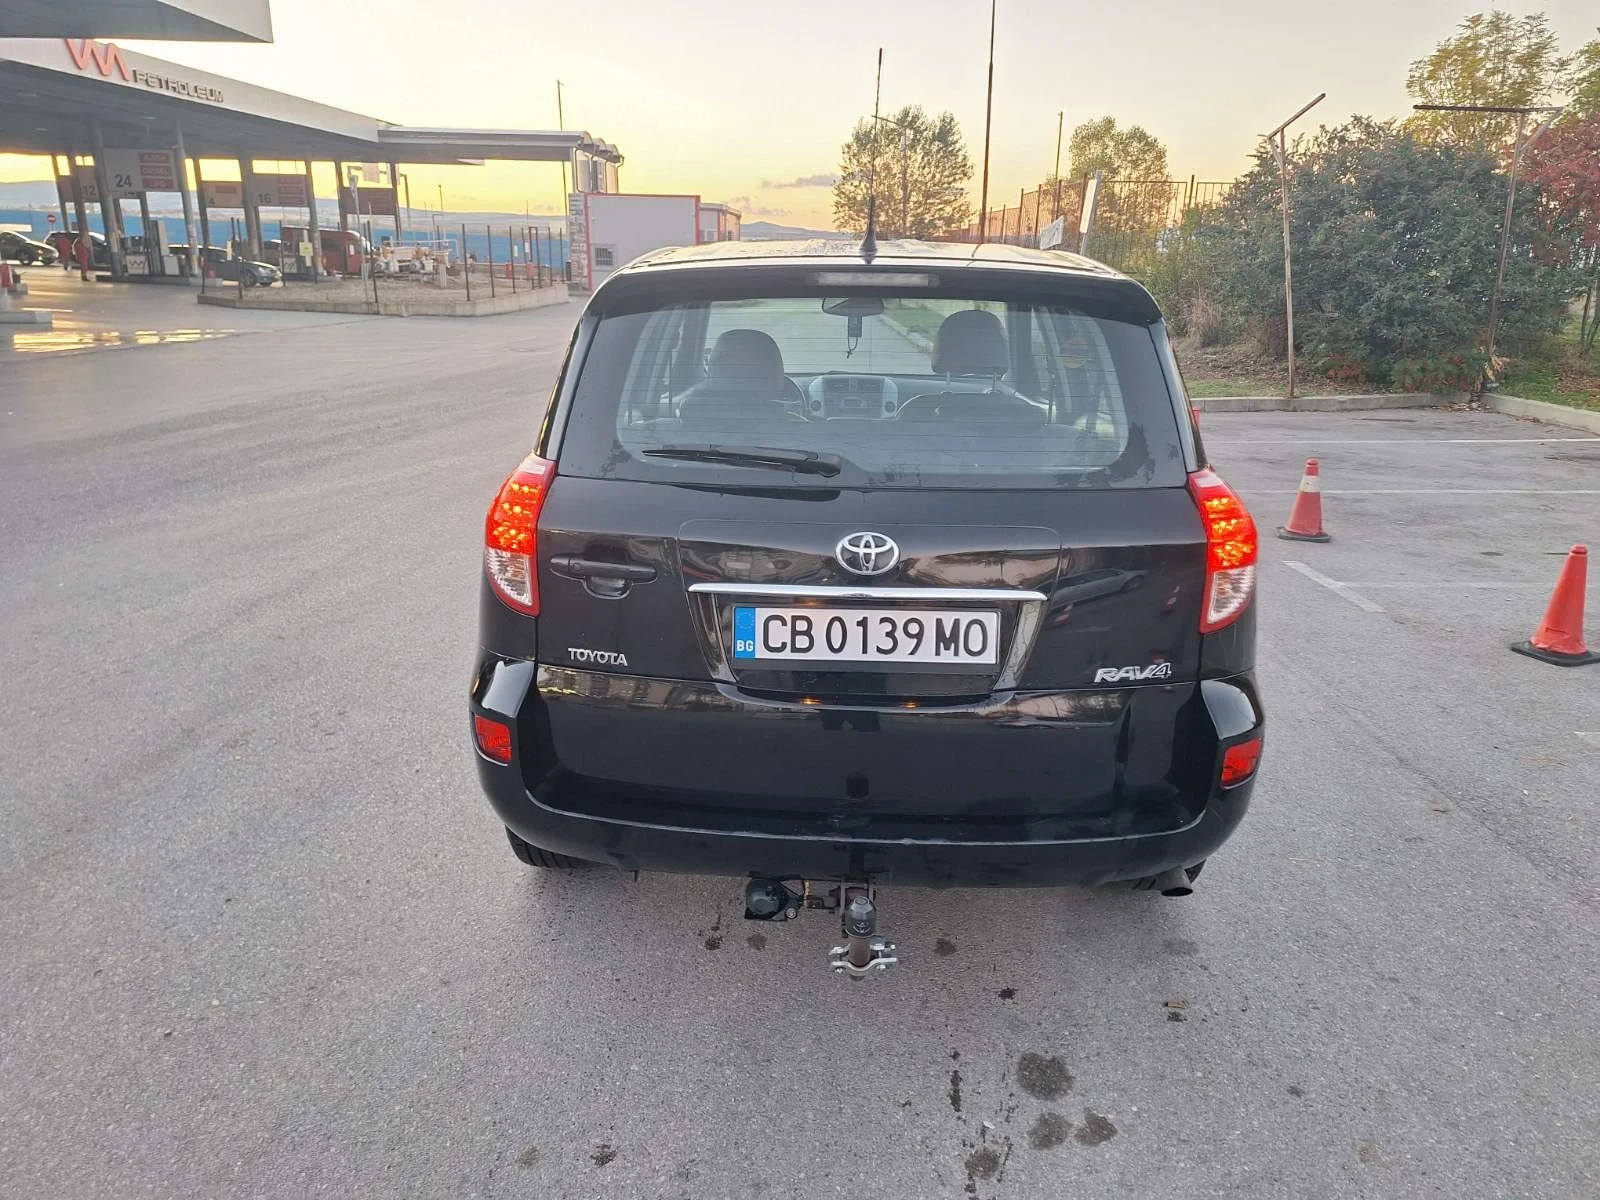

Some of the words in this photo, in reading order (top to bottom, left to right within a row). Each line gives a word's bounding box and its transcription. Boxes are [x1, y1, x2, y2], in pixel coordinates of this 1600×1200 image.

[132, 69, 224, 103] PETROLEUM
[114, 173, 133, 188] 24
[763, 614, 815, 653] CB
[825, 616, 925, 655] 0139
[935, 617, 988, 657] MO
[736, 640, 754, 652] BG
[567, 647, 628, 667] TOYOTA
[1094, 662, 1172, 683] RAV4
